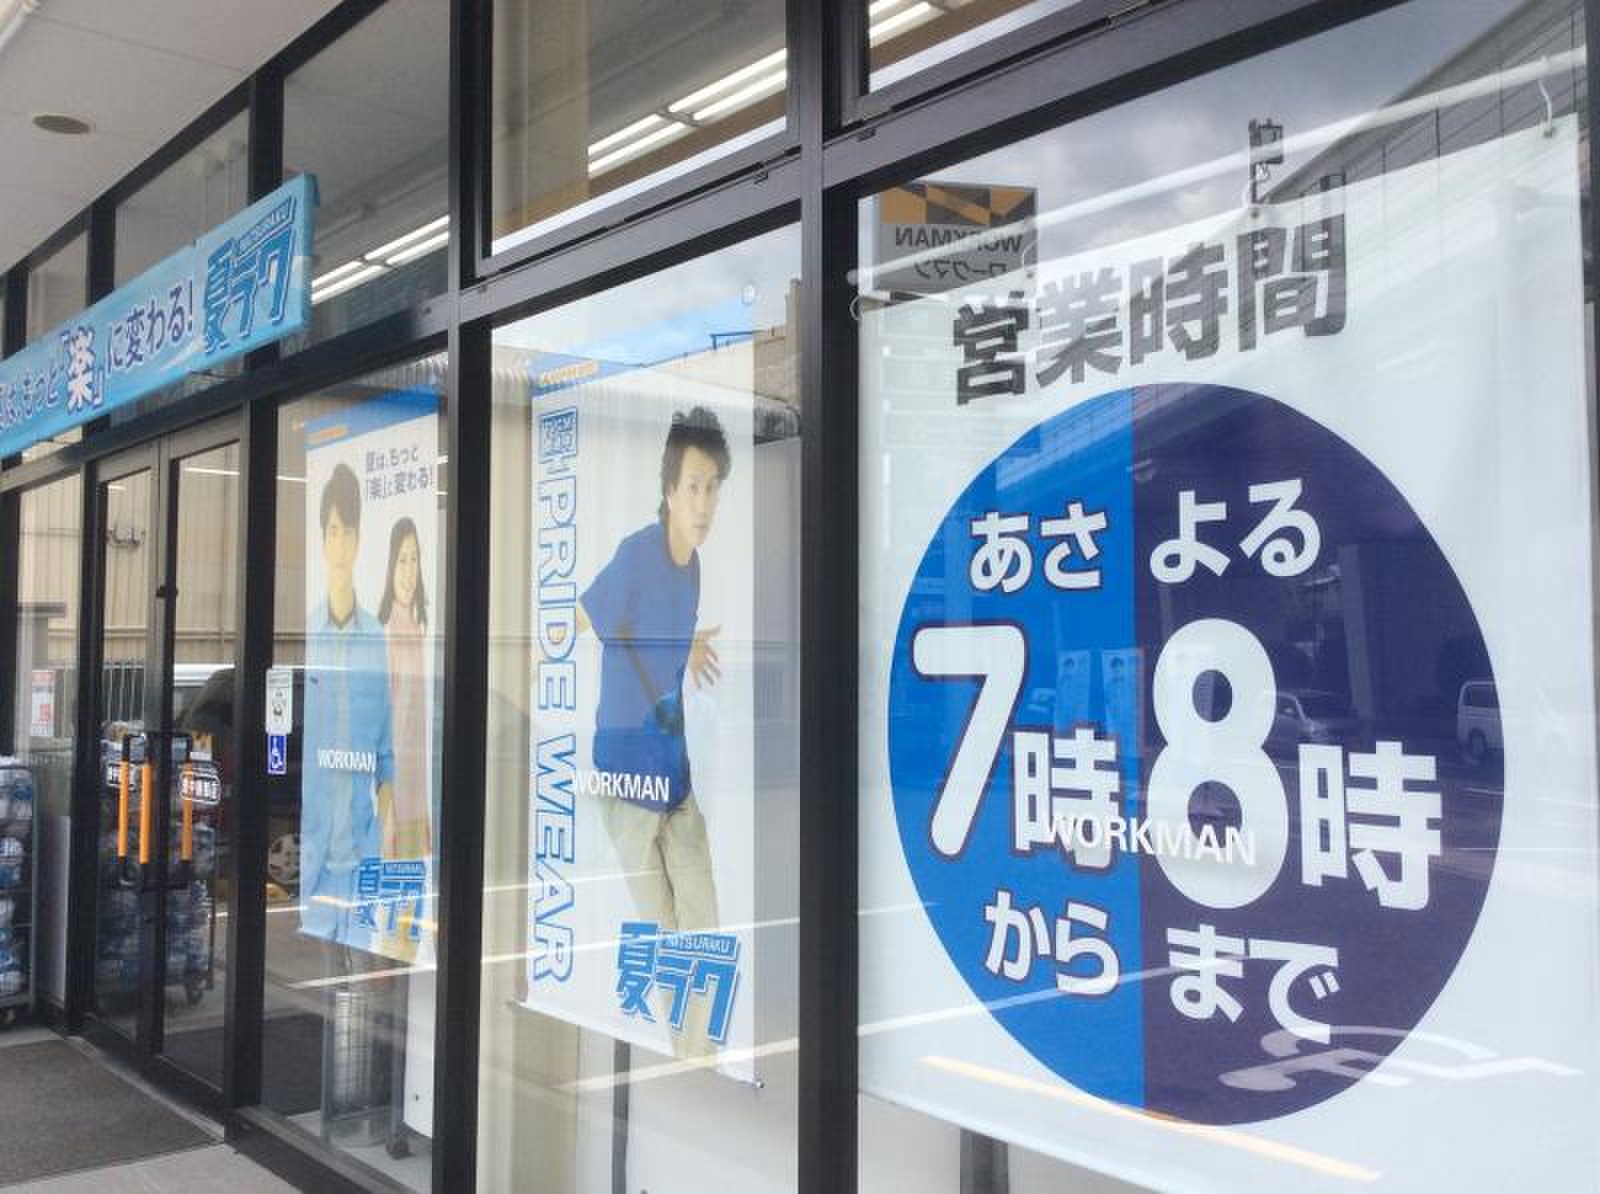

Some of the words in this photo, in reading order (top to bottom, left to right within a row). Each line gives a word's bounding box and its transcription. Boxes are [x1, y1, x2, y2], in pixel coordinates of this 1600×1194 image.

[953, 213, 1347, 405] 営業時間
[969, 502, 1108, 593] あさ
[1149, 478, 1322, 584] よる
[318, 749, 376, 771] WORKMAN
[573, 770, 670, 802] WORKMAN
[912, 623, 1120, 868] 7時
[1147, 618, 1443, 911] 8時
[533, 733, 577, 983] WEAR
[1044, 813, 1256, 864] WORKMAN
[984, 890, 1120, 996] から
[1167, 923, 1341, 1044] まで
